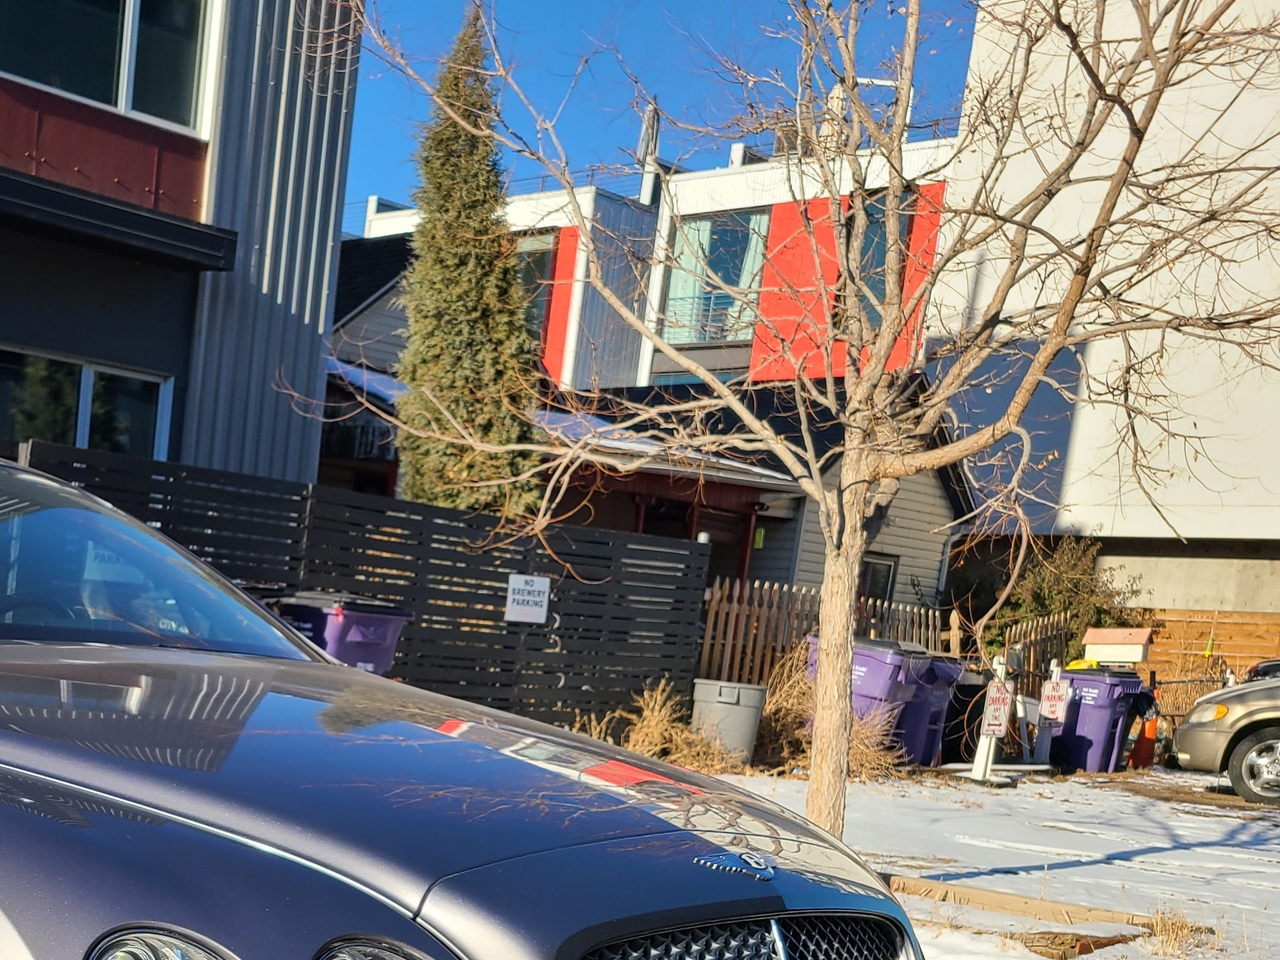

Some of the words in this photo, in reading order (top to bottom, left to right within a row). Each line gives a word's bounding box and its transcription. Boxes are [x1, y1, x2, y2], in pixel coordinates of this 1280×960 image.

[524, 579, 534, 588] NO
[512, 588, 546, 599] BREWERY
[511, 598, 543, 608] PARKING
[1044, 694, 1065, 703] PARKING
